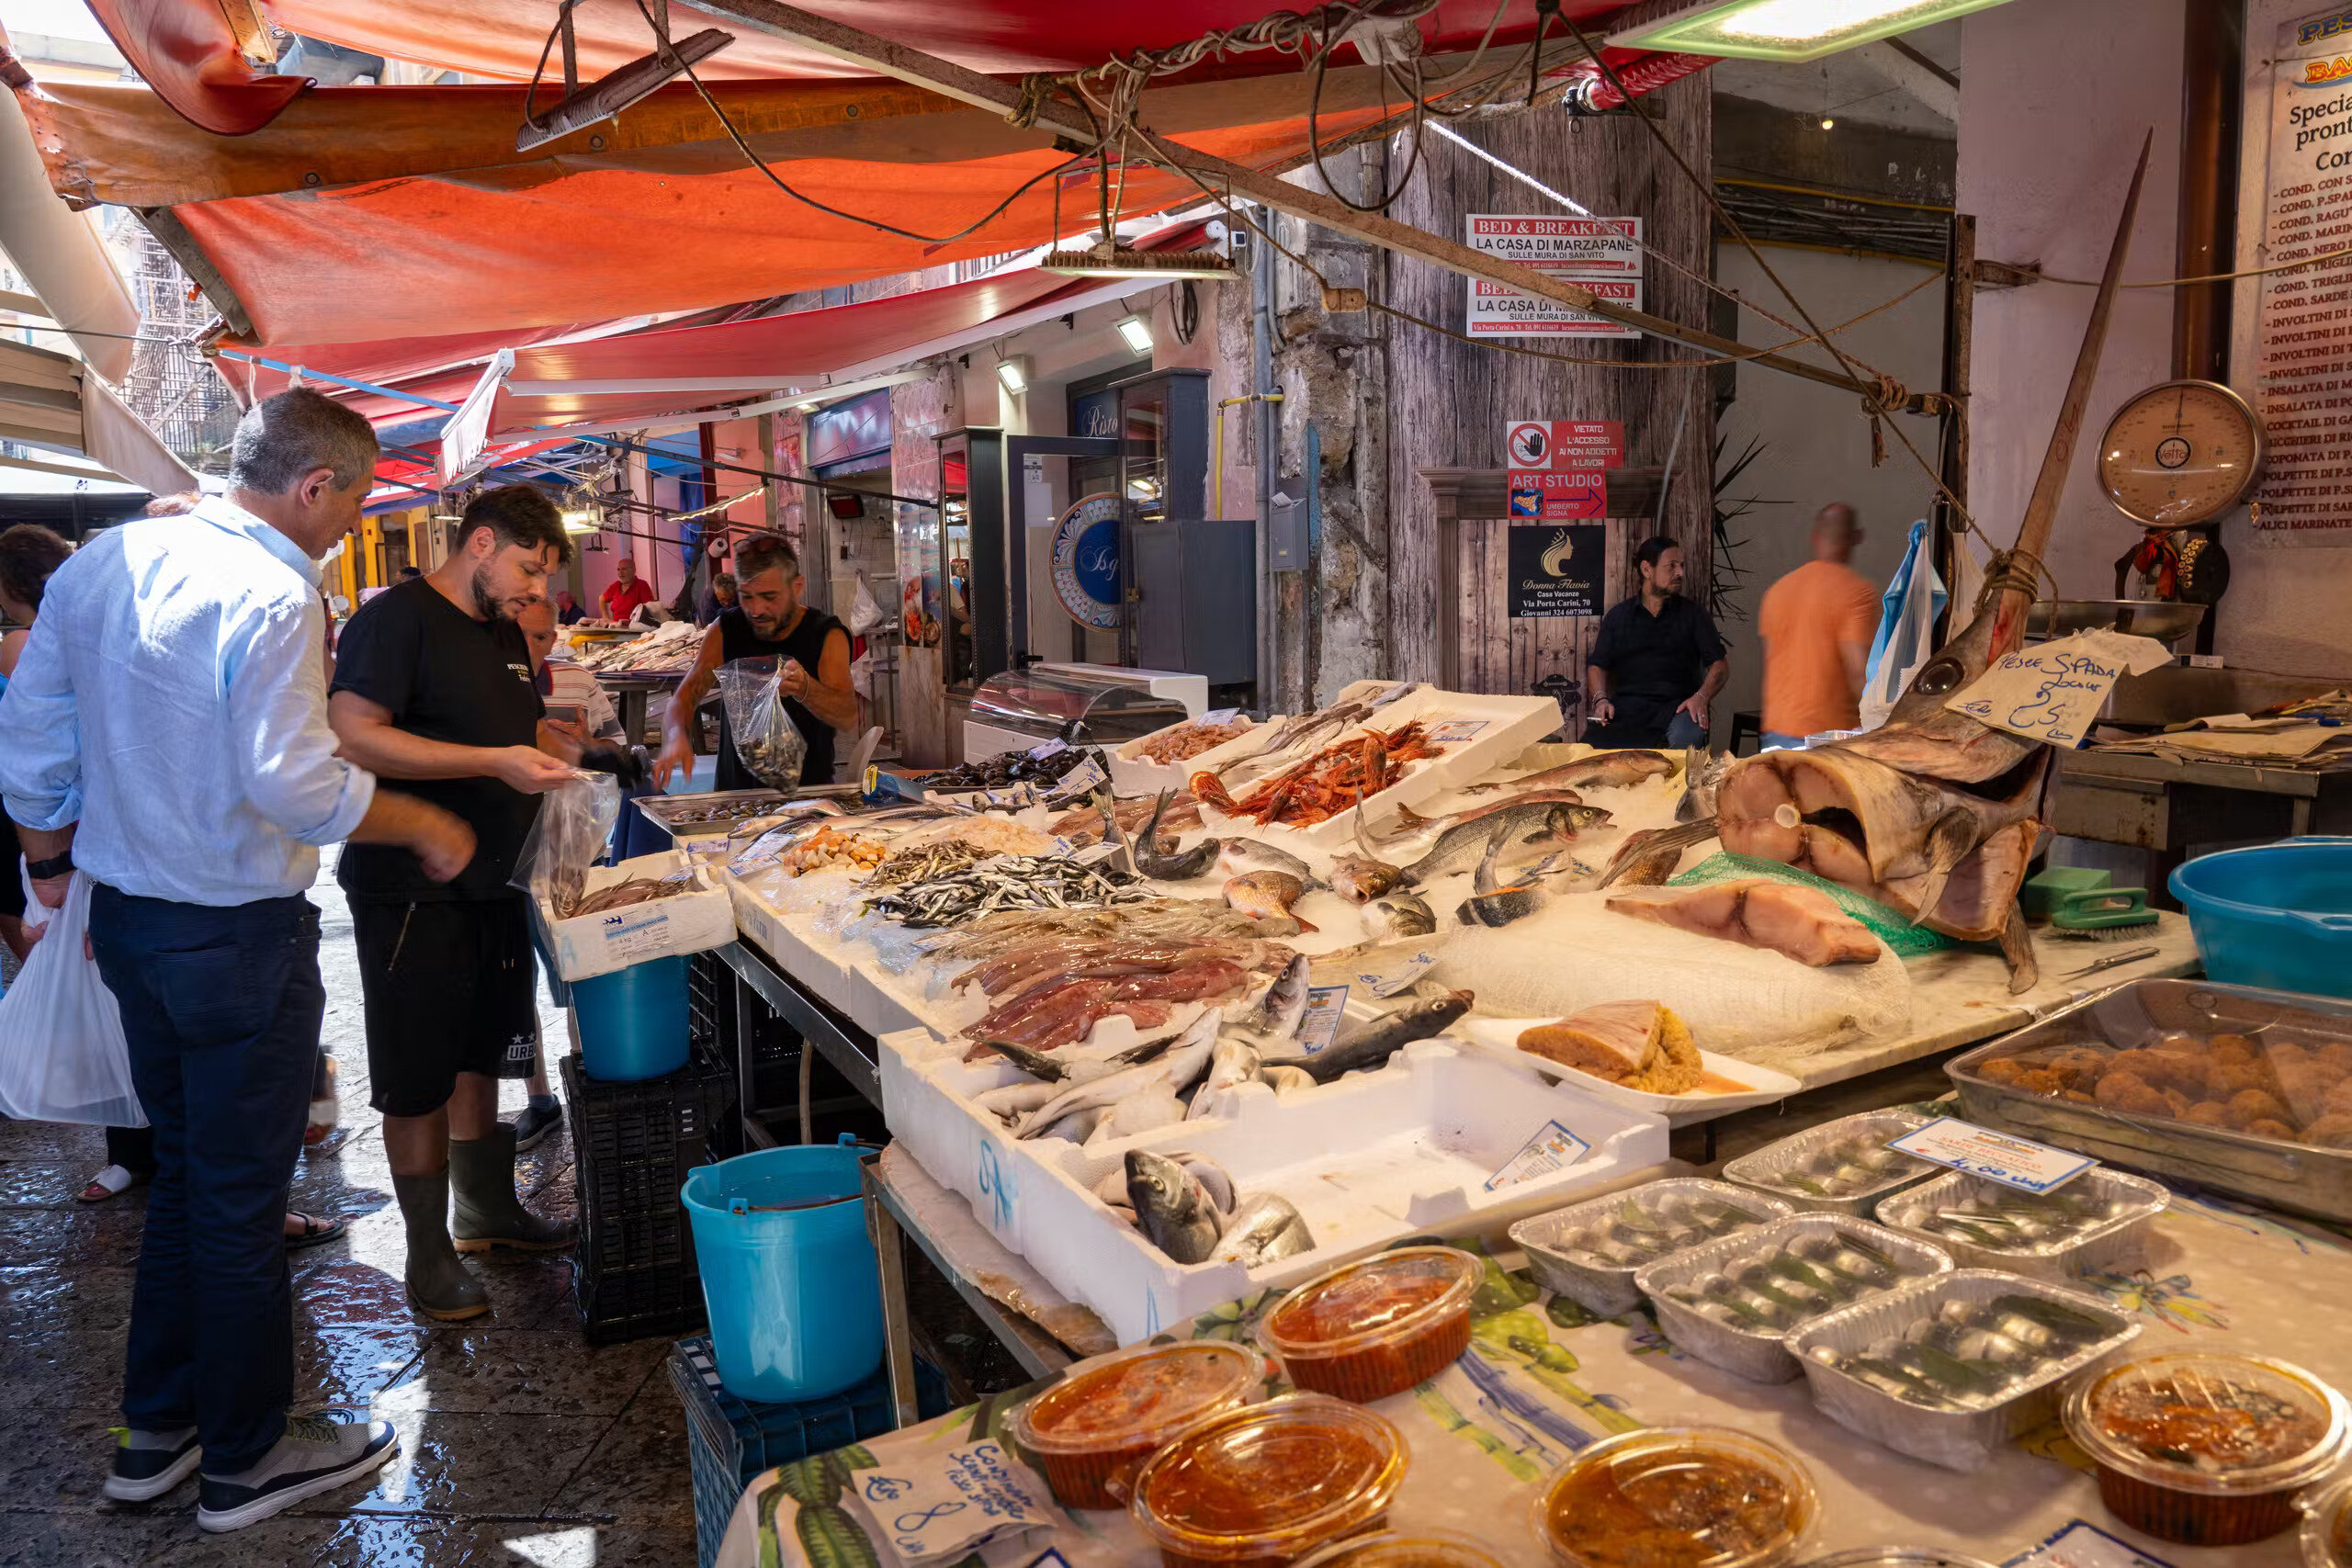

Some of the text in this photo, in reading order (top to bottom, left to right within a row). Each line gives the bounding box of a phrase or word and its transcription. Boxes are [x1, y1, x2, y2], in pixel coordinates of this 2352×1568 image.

[2305, 57, 2352, 84] BA
[2280, 184, 2315, 198] COND.
[2318, 176, 2343, 190] CON
[2279, 199, 2314, 214] COND.
[1479, 220, 1512, 233] BED
[1516, 221, 1530, 233] &
[2278, 216, 2313, 230] COND.
[1476, 238, 1634, 251] LA CASA DI MARZAPANE
[2278, 231, 2312, 245] COND.
[2277, 242, 2346, 262] COND. NERO
[2274, 281, 2309, 294] COND.
[1477, 300, 1494, 311] LA
[1498, 300, 1535, 312] CASA
[2273, 290, 2348, 310] COND. SARDE
[2272, 309, 2347, 328] INVOLTINI DI
[2271, 327, 2346, 345] INVOLTINI DI
[2270, 346, 2330, 363] INVOLTINI
[2332, 344, 2345, 355] DI
[2269, 365, 2329, 380] INVOLTINI
[2331, 363, 2344, 373] DI
[2267, 382, 2324, 397] INSALATA
[2326, 380, 2339, 390] DI
[2267, 400, 2323, 414] INSALATA
[2324, 399, 2337, 409] DI
[2267, 418, 2322, 432] COCKTAIL
[2324, 417, 2337, 426] DI
[1566, 436, 1610, 445] L'ACCESSO
[2324, 434, 2336, 443] DI
[2327, 450, 2341, 460] DI
[1512, 474, 1603, 488] ART STUDIO
[2263, 469, 2318, 481] POLPETTE
[2321, 468, 2334, 479] DI
[2261, 487, 2316, 498] POLPETTE
[2319, 486, 2331, 496] DI
[2318, 502, 2331, 513] DI
[1522, 579, 1590, 591] Donna Flavia
[1556, 599, 1581, 607] Carini,
